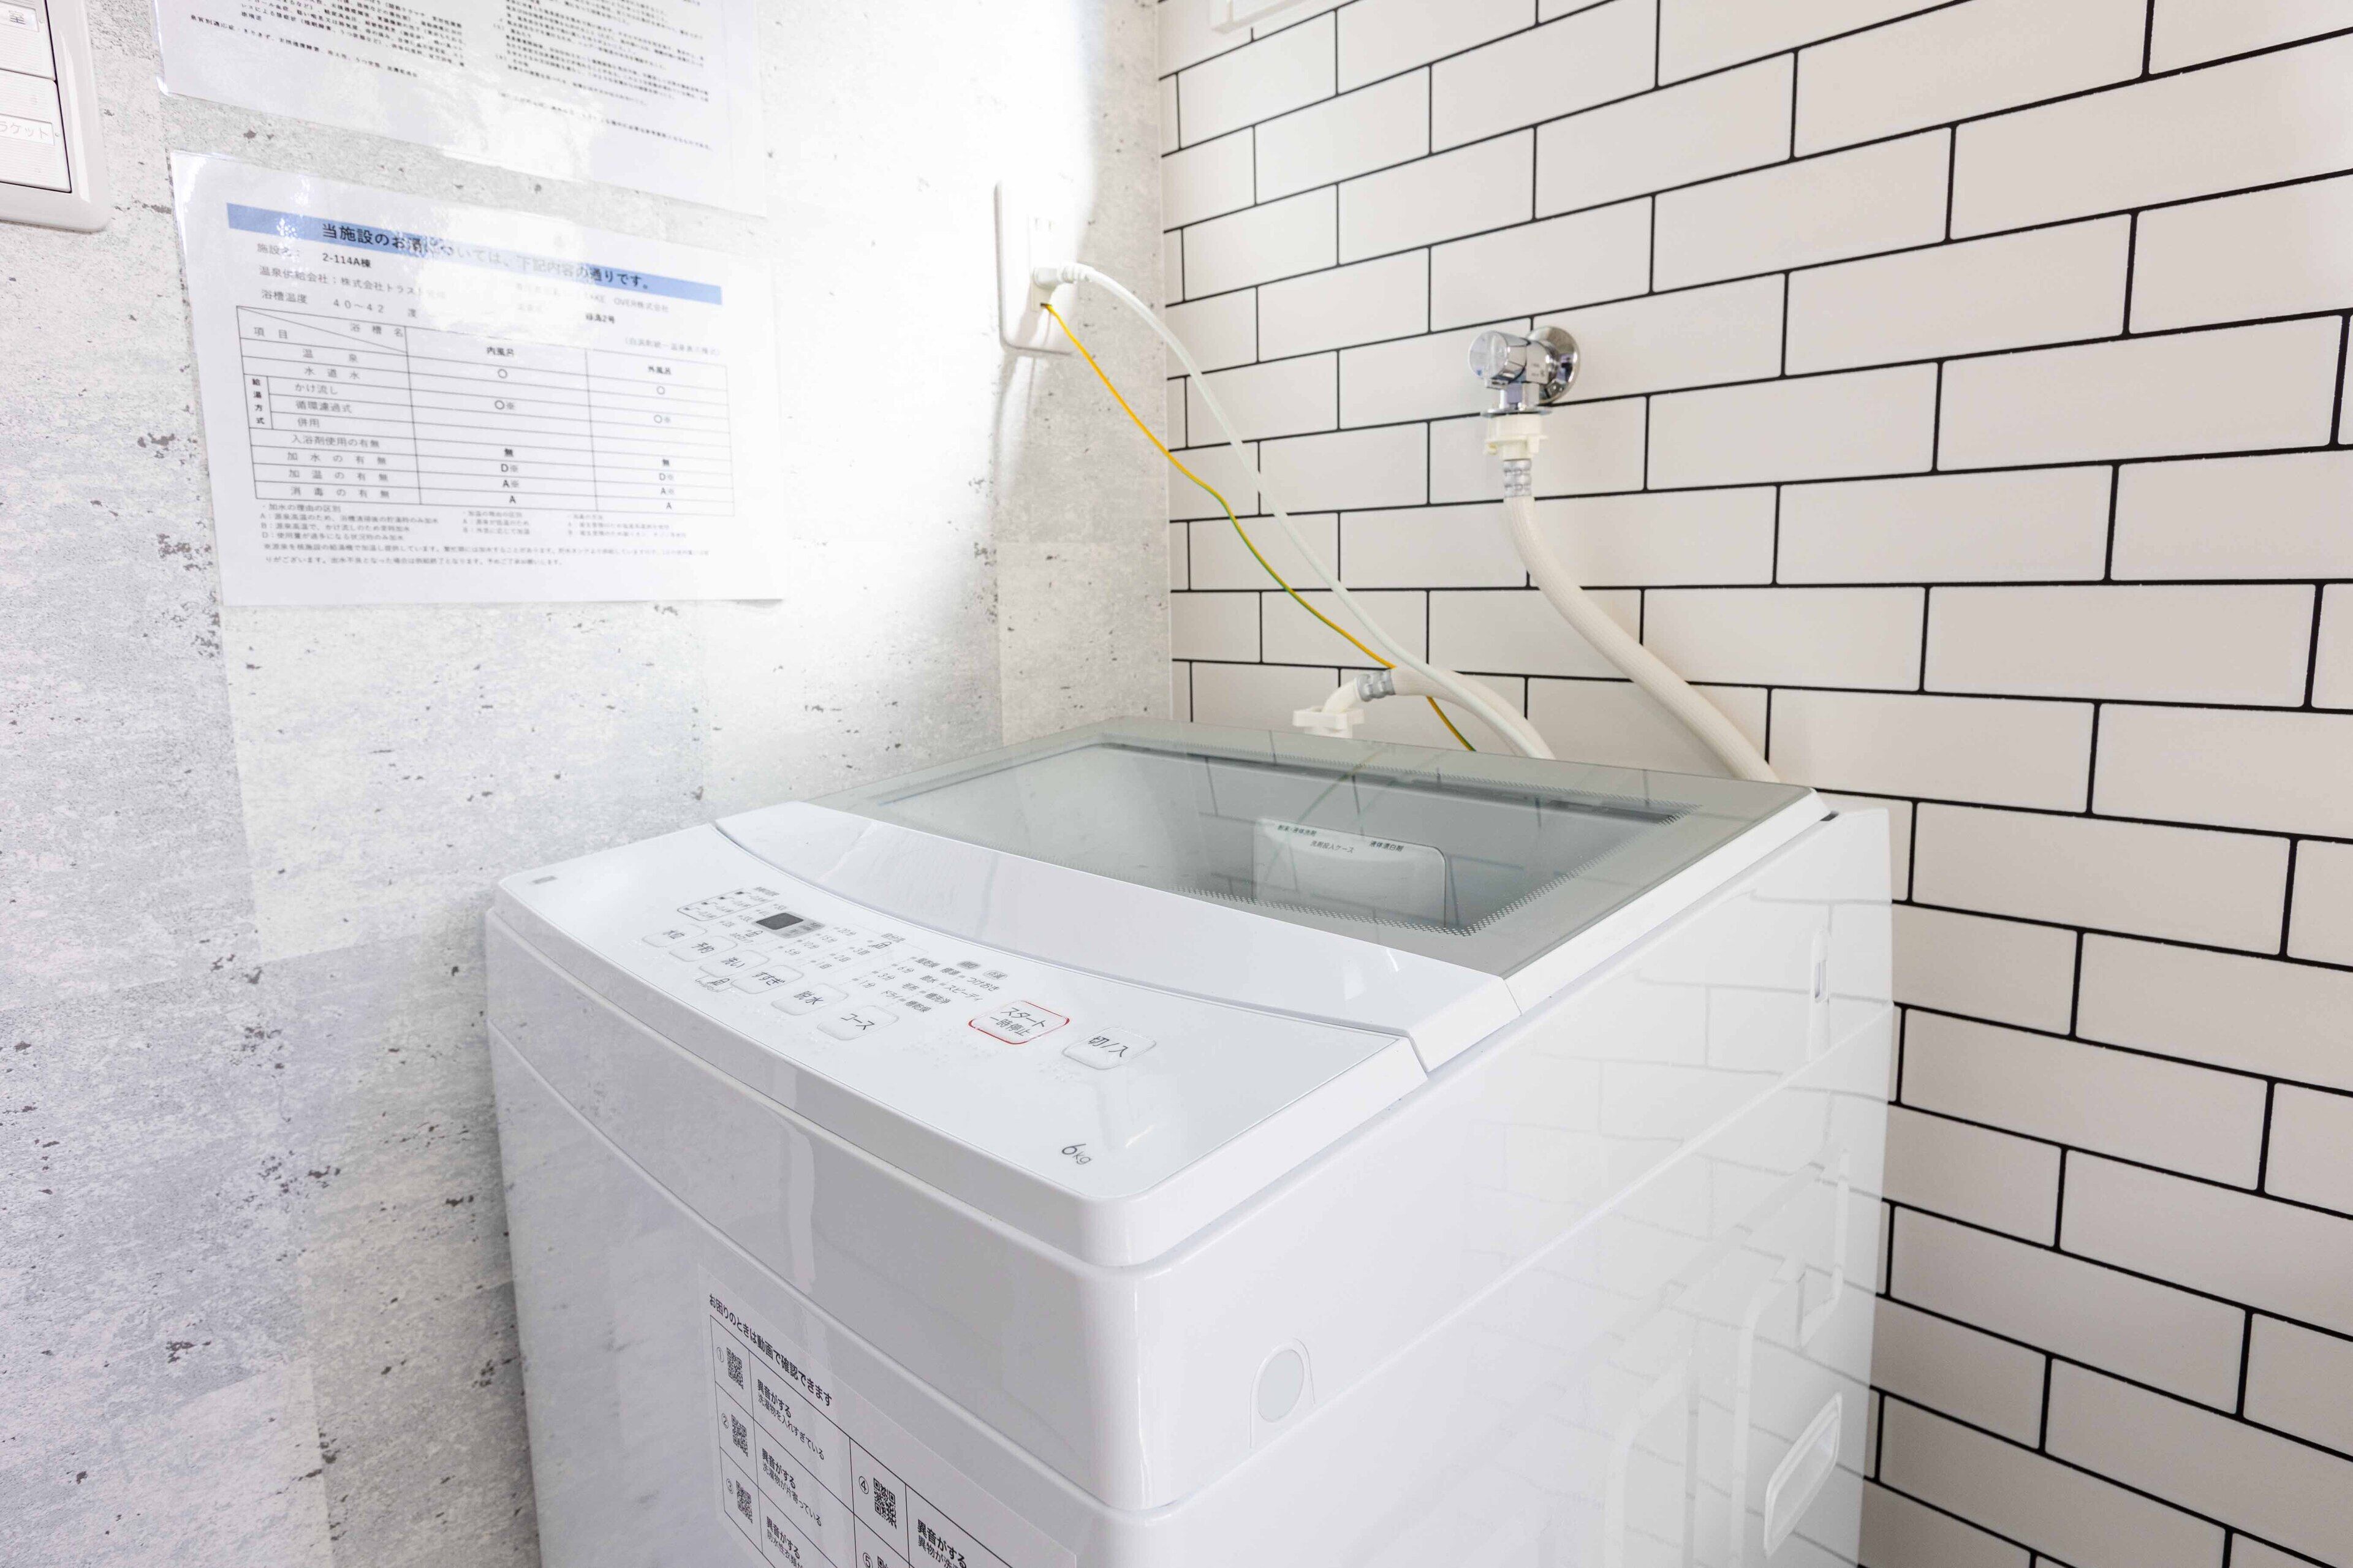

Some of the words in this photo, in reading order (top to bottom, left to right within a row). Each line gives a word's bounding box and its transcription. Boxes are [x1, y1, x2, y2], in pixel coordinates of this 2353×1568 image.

[295, 384, 338, 395] かけ流し
[297, 417, 320, 428] 併用
[720, 957, 746, 969] 洗い
[751, 971, 786, 986] すすぎ
[966, 977, 1001, 992] つけおき
[793, 990, 824, 1005] 脱水
[840, 1013, 876, 1031] コース
[990, 1015, 1031, 1036] 一時停止
[1000, 1007, 1046, 1028] スタート
[708, 1293, 832, 1407] お困りのときは動画で確認できます
[757, 1378, 792, 1418] 異音がする
[757, 1393, 825, 1460] 洗濯物を入れすぎている
[762, 1447, 796, 1490] 異音がする
[762, 1462, 822, 1527] 洗濯物が片寄っている
[766, 1515, 800, 1559] 異音がする
[917, 1518, 967, 1568] 異音がする
